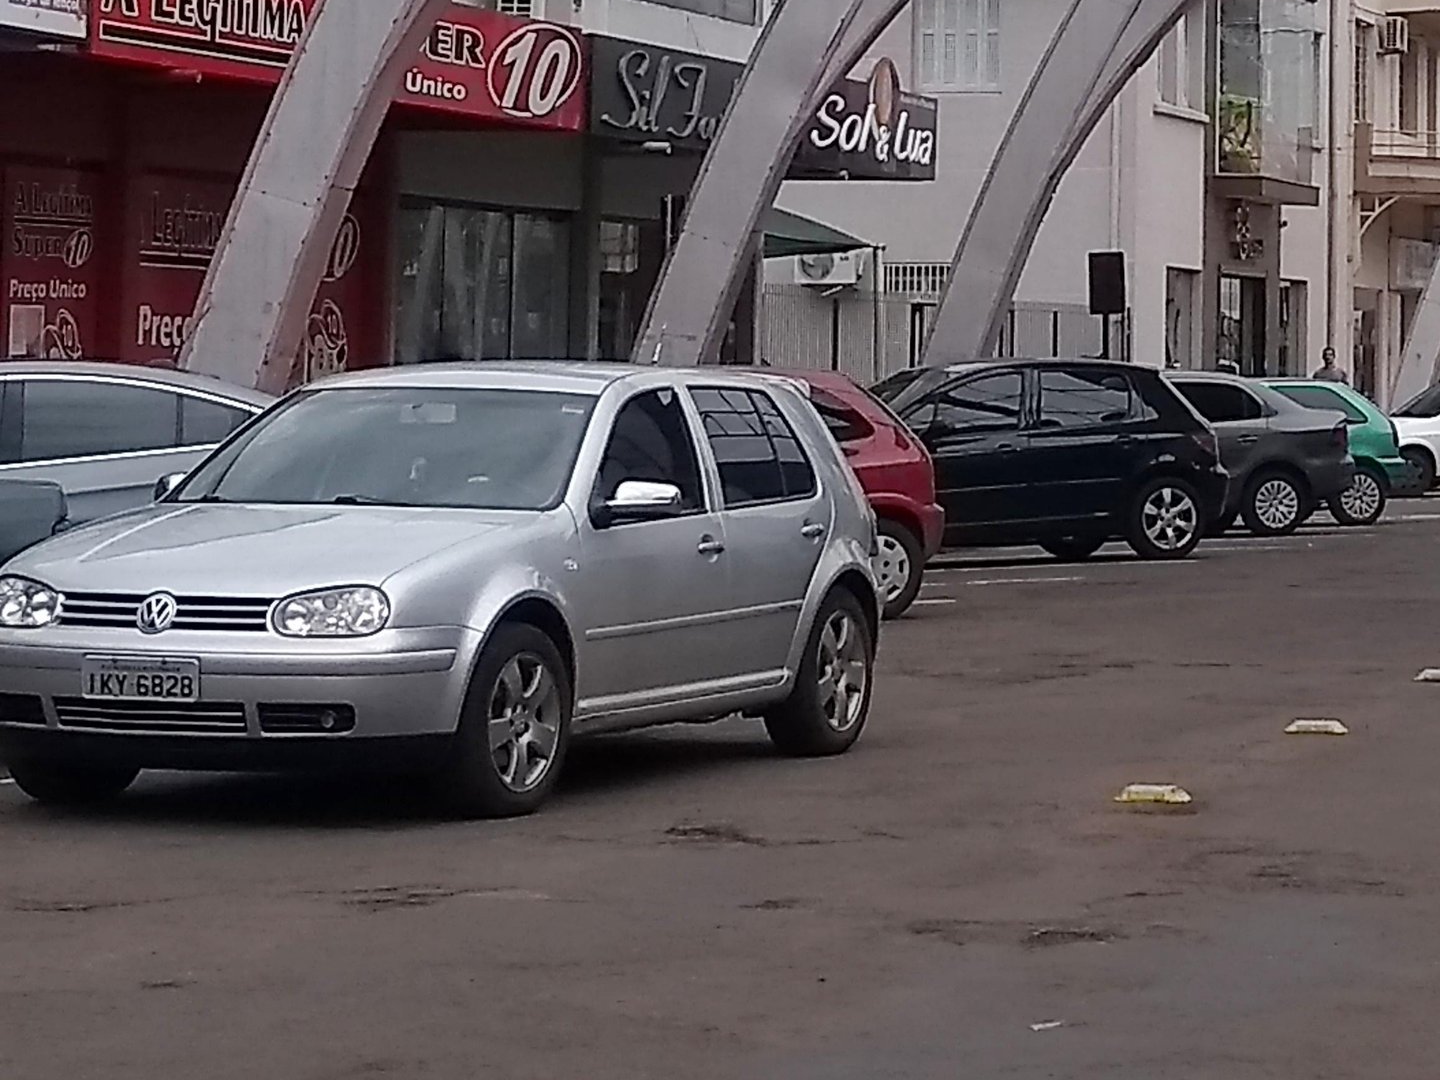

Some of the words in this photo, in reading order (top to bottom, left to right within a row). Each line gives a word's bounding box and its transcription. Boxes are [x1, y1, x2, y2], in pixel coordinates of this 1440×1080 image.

[406, 68, 467, 101] Único
[421, 21, 486, 68] ER
[503, 32, 571, 116] 10
[810, 94, 879, 152] Sol
[875, 125, 891, 162] &
[894, 111, 933, 165] Lua
[64, 231, 91, 267] 10
[9, 278, 47, 302] Preço
[49, 275, 87, 298] Único
[89, 672, 128, 696] IKY
[136, 674, 193, 698] 6828
